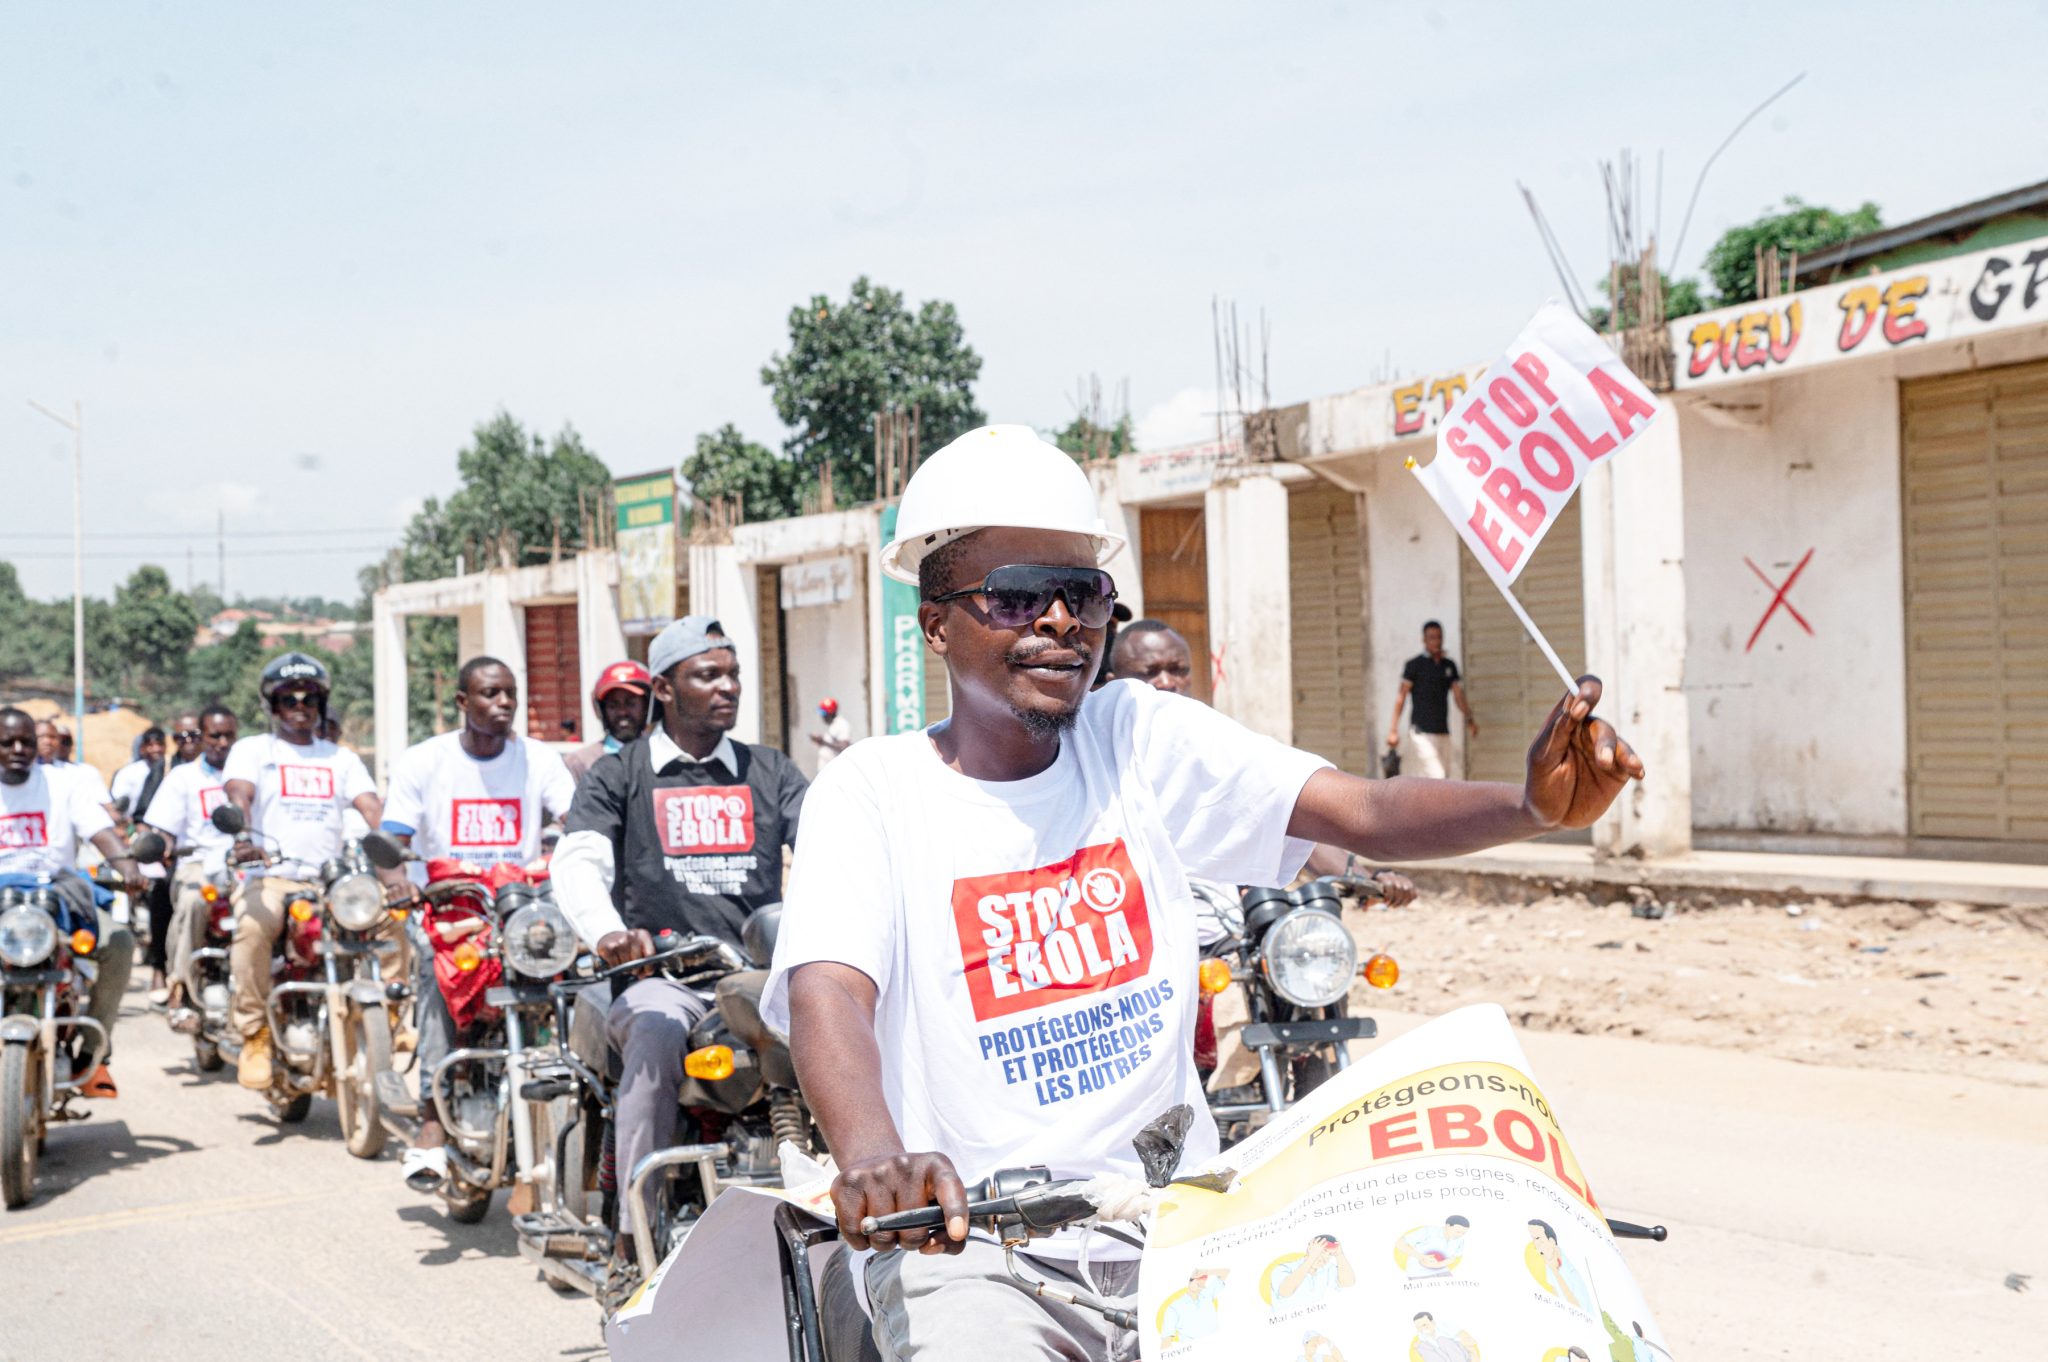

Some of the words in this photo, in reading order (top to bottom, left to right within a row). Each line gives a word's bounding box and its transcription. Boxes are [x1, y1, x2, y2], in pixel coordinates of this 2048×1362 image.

[1688, 298, 1801, 378] DIEU
[1838, 276, 1929, 352] DE
[1446, 352, 1559, 477] STOP
[1467, 366, 1656, 574] EBOLA
[458, 803, 502, 821] STOP
[458, 820, 517, 843] EBOLA
[665, 794, 724, 820] STOP
[667, 818, 747, 848] EBOLA
[977, 876, 1081, 948] STOP
[987, 911, 1139, 999] EBOLA
[978, 979, 1174, 1060] PROTÉGEONS-NOUS
[1003, 1055, 1027, 1085] ET
[1031, 1012, 1164, 1078] PROTÉGEONS
[1035, 1075, 1074, 1106] LES
[1078, 1044, 1152, 1095] AUTRES
[1339, 1179, 1378, 1194] d'un
[1385, 1173, 1408, 1186] de
[1415, 1167, 1448, 1181] ces
[1454, 1165, 1520, 1187] signes,
[1369, 1104, 1600, 1211] EBOL
[1313, 1199, 1363, 1218] santé
[1371, 1194, 1387, 1207] le
[1394, 1189, 1433, 1204] plus
[1269, 1313, 1288, 1325] Mal
[1290, 1308, 1303, 1318] de
